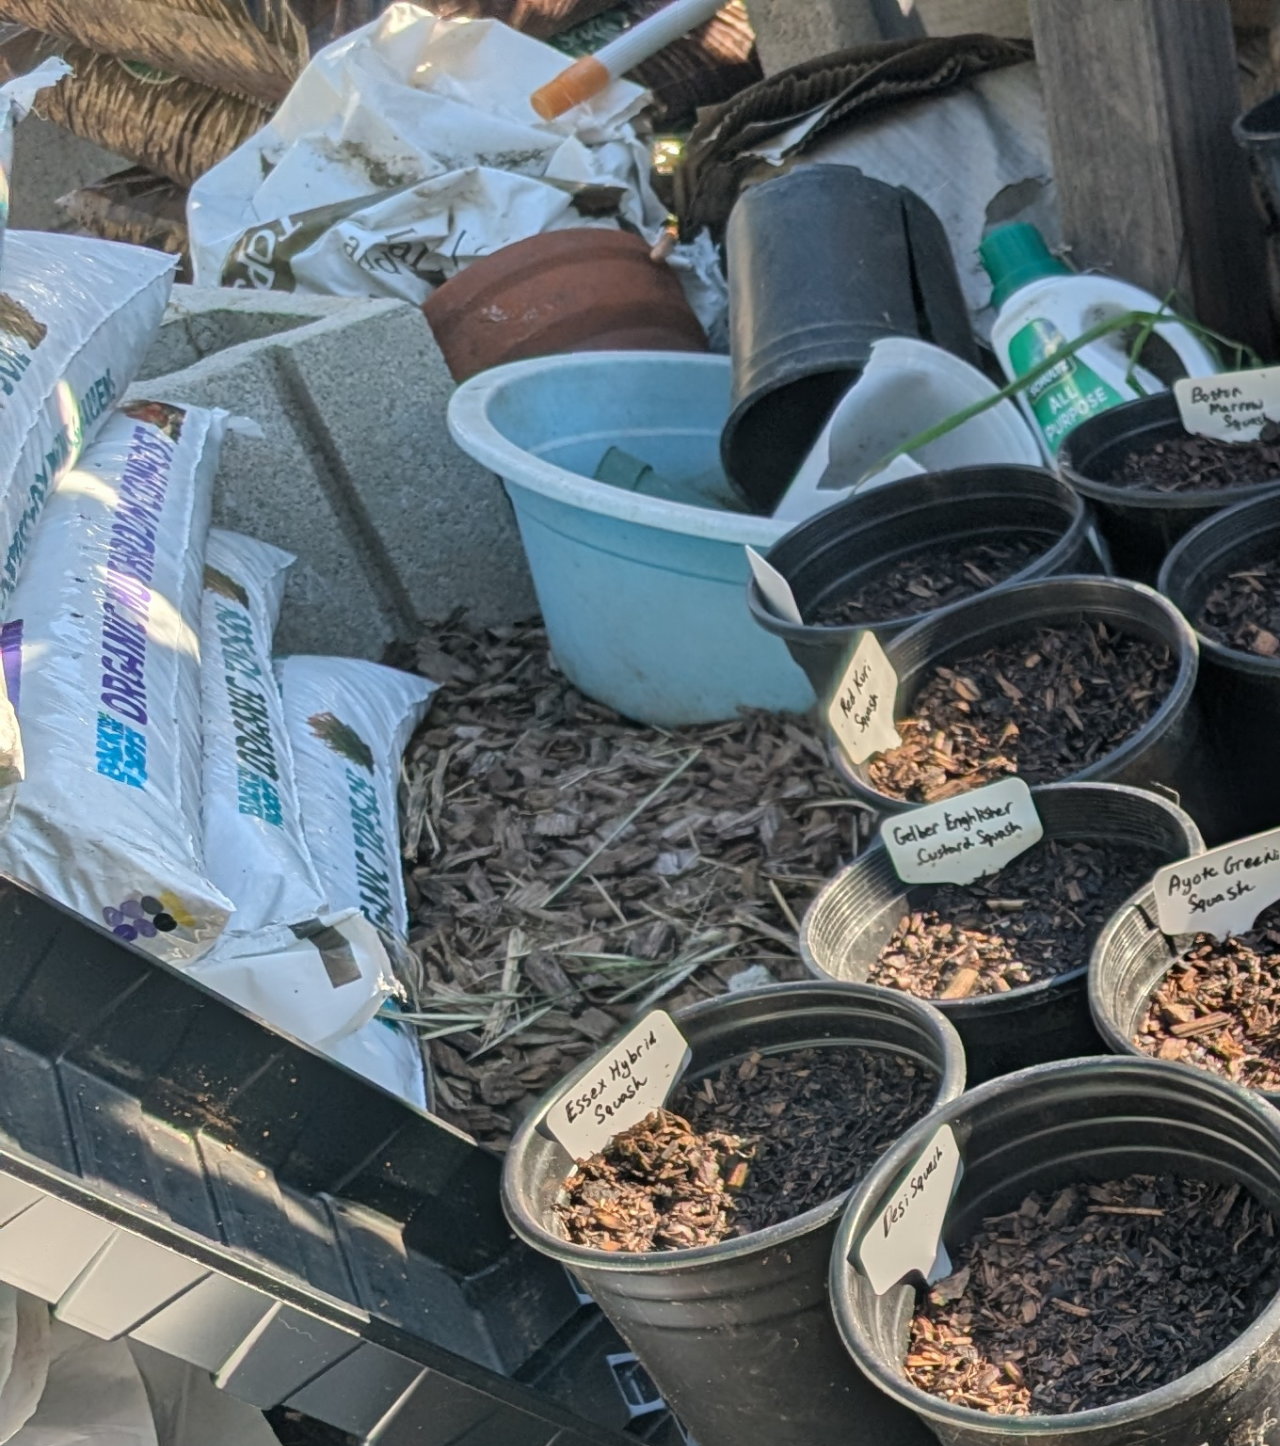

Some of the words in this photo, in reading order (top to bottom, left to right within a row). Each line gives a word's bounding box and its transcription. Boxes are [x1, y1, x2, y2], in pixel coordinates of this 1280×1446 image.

[1046, 387, 1108, 442] PURPOSE
[1050, 386, 1079, 413] ALL
[1191, 386, 1242, 403] Boston
[100, 598, 150, 726] ORGANIC
[839, 687, 857, 719] Red
[856, 659, 874, 696] Kuri
[854, 694, 879, 733] Squash
[916, 836, 976, 866] Custard
[976, 821, 1024, 848] Squash
[1168, 866, 1220, 898] Ayote
[1188, 879, 1257, 915] Squash
[565, 1078, 608, 1124] Essex
[608, 1030, 658, 1082] Hybrid
[594, 1075, 649, 1126] Squash
[882, 1193, 910, 1239] Desi
[909, 1145, 944, 1200] Squash
